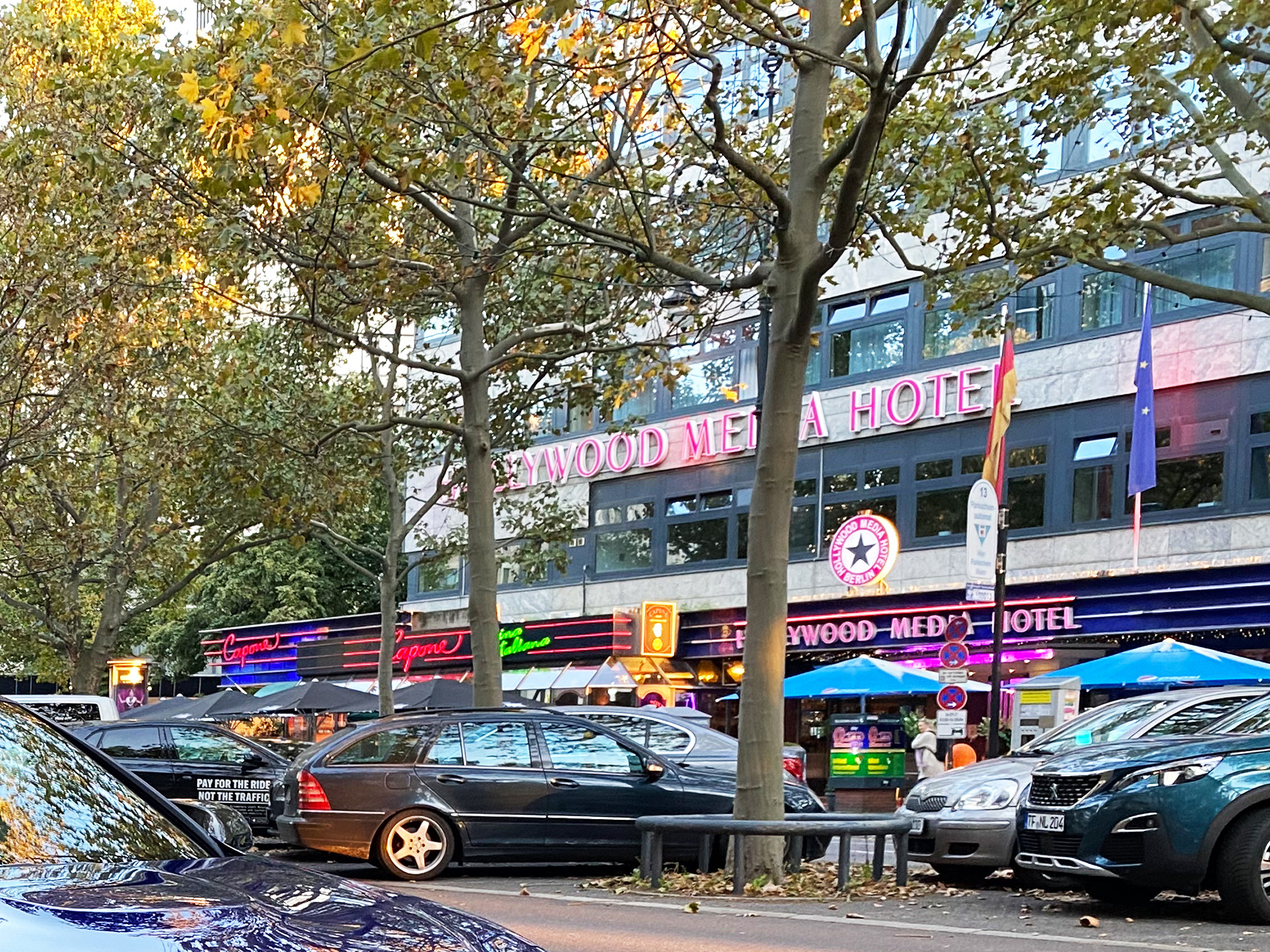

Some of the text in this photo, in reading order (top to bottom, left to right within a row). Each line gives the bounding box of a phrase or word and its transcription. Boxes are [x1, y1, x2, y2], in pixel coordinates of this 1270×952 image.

[681, 391, 828, 461] MEA
[859, 519, 886, 540] MEDIA
[872, 539, 889, 570] HOTEL
[843, 569, 876, 584] BERLIN
[735, 619, 877, 649] HYWOOD
[889, 611, 975, 639] MEDA
[223, 632, 280, 668] Capone
[197, 779, 271, 789] PAY FOR THE RIDE
[198, 791, 271, 802] NOT THE TRAFFIC
